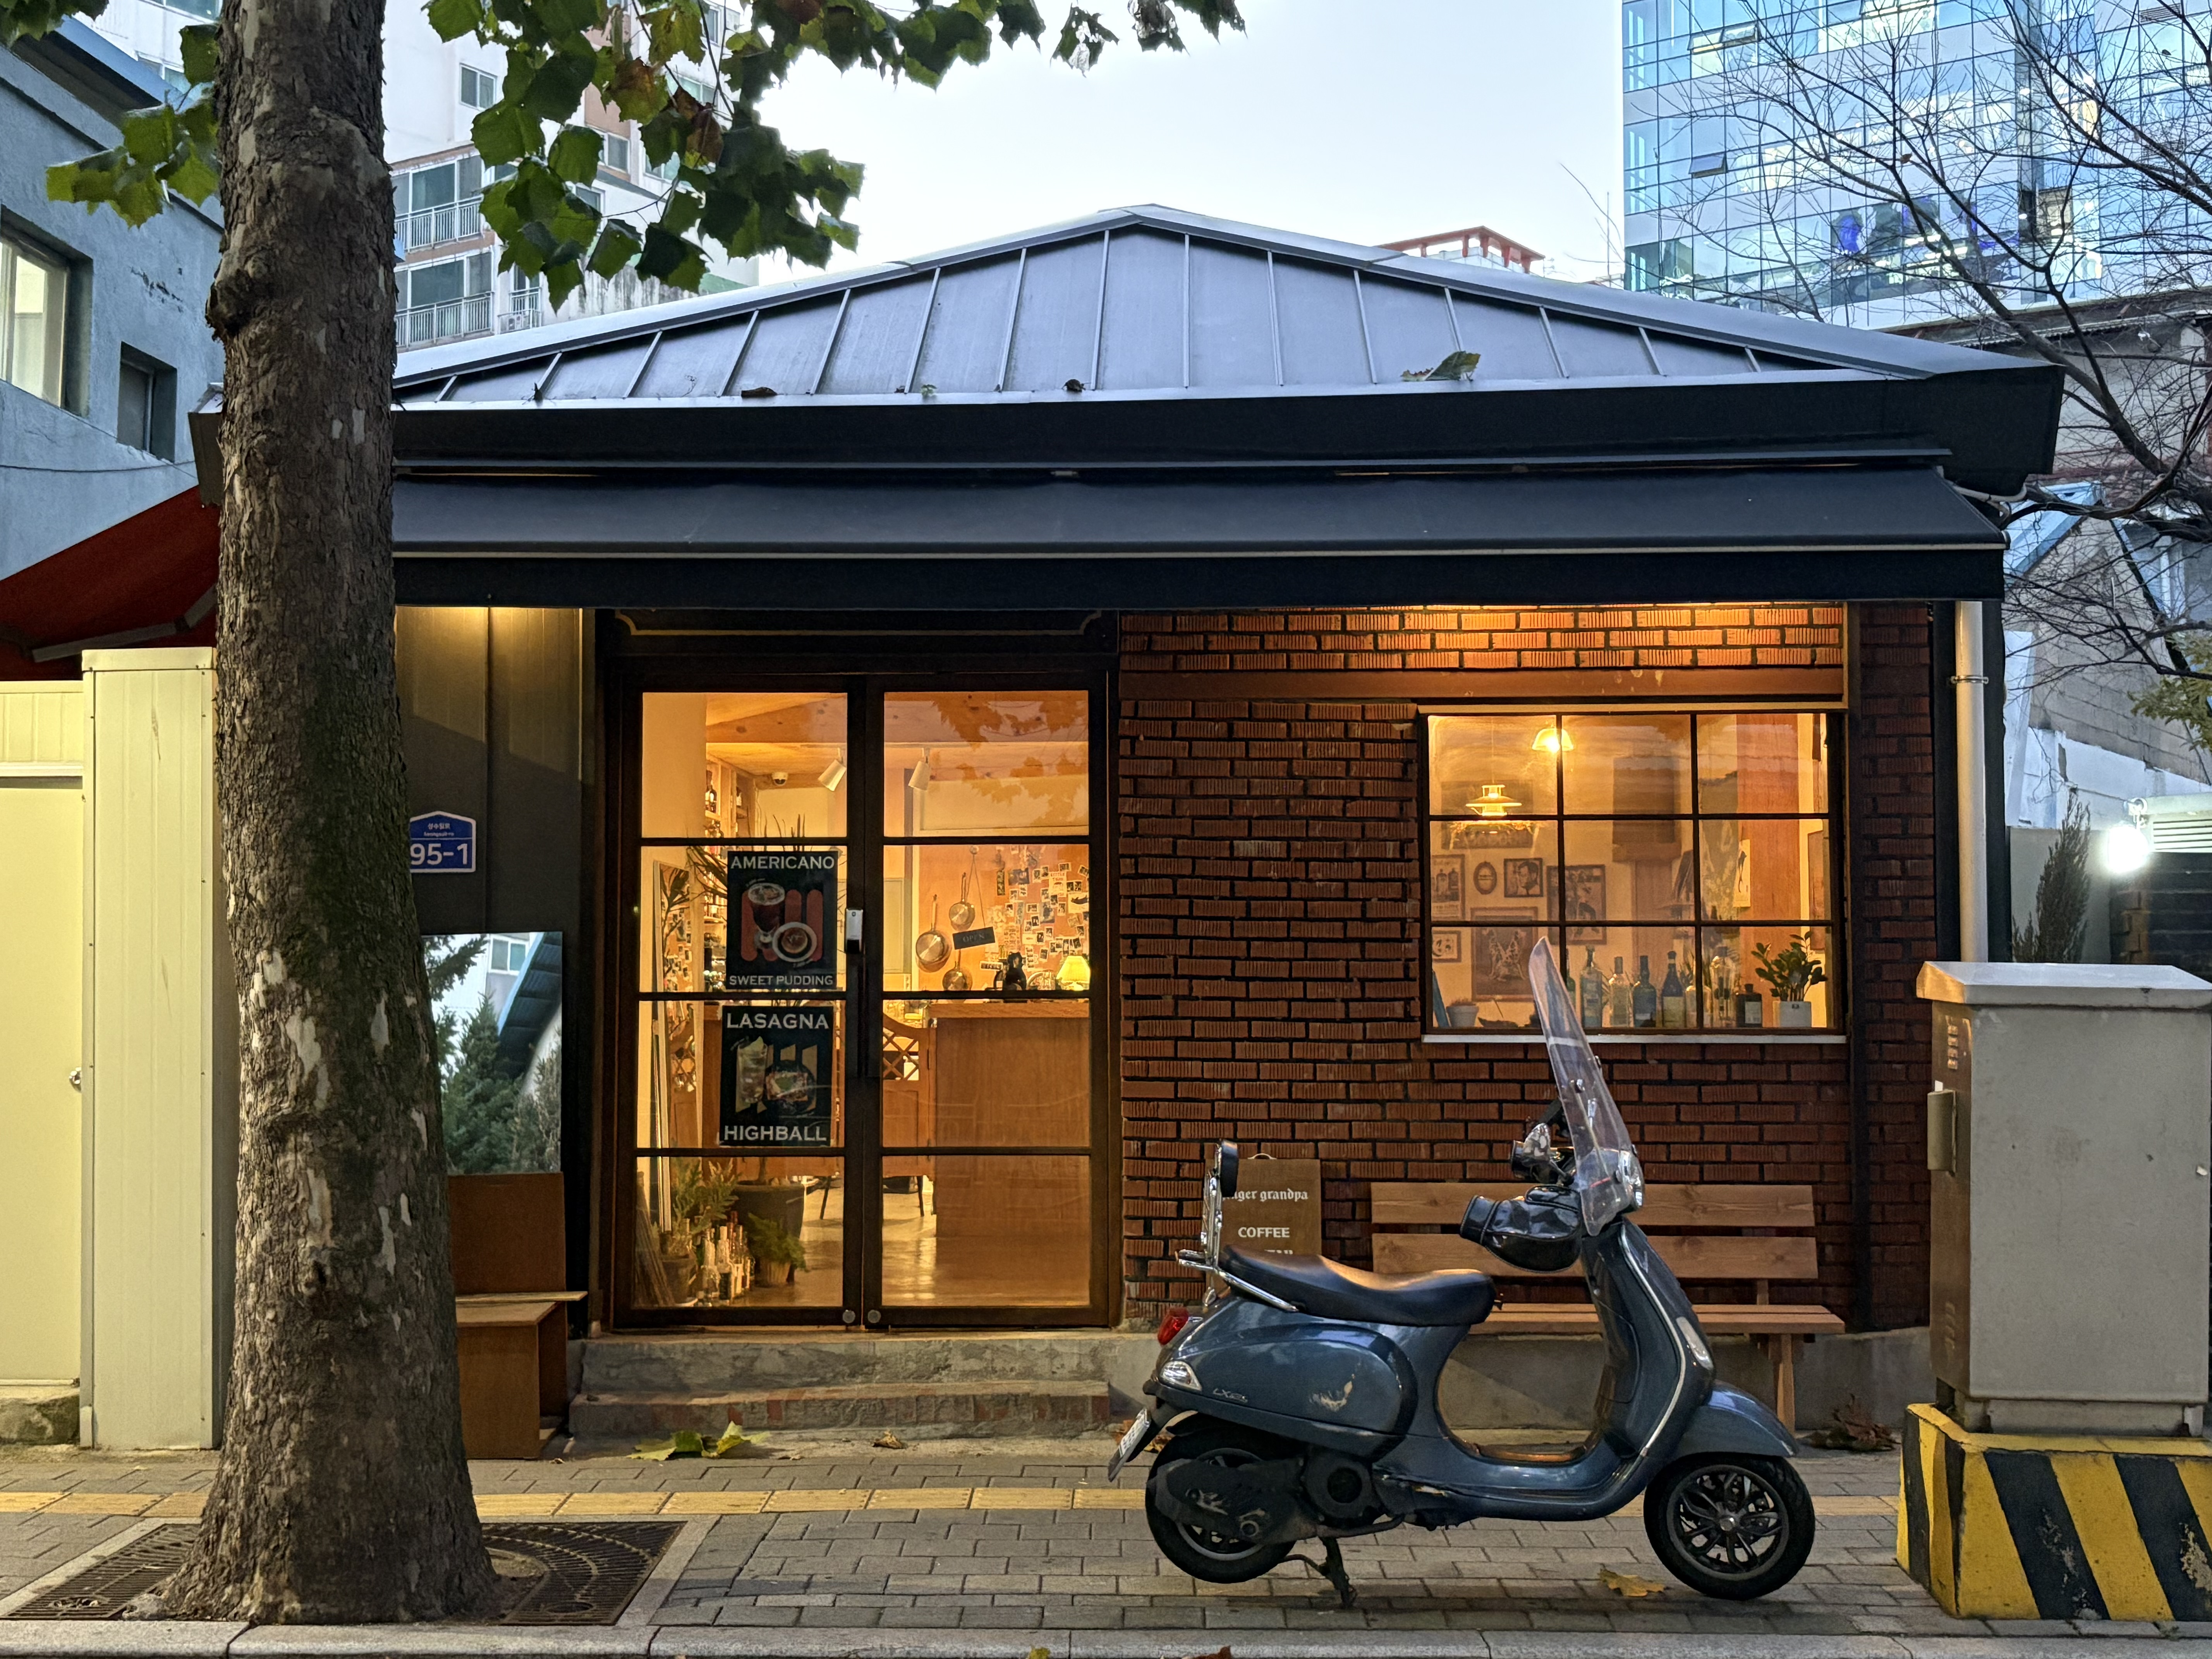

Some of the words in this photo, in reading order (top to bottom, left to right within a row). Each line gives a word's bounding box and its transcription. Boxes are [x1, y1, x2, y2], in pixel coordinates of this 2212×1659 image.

[410, 843, 468, 865] 95-1
[730, 856, 835, 869] AMERICANO
[729, 975, 774, 985] SWEET
[776, 975, 833, 985] PUDDING
[726, 1013, 830, 1029] LASAGNA
[724, 1125, 827, 1141] HIGHBALL
[1260, 1188, 1308, 1202] grandpa
[1238, 1227, 1290, 1238] COFFEE
